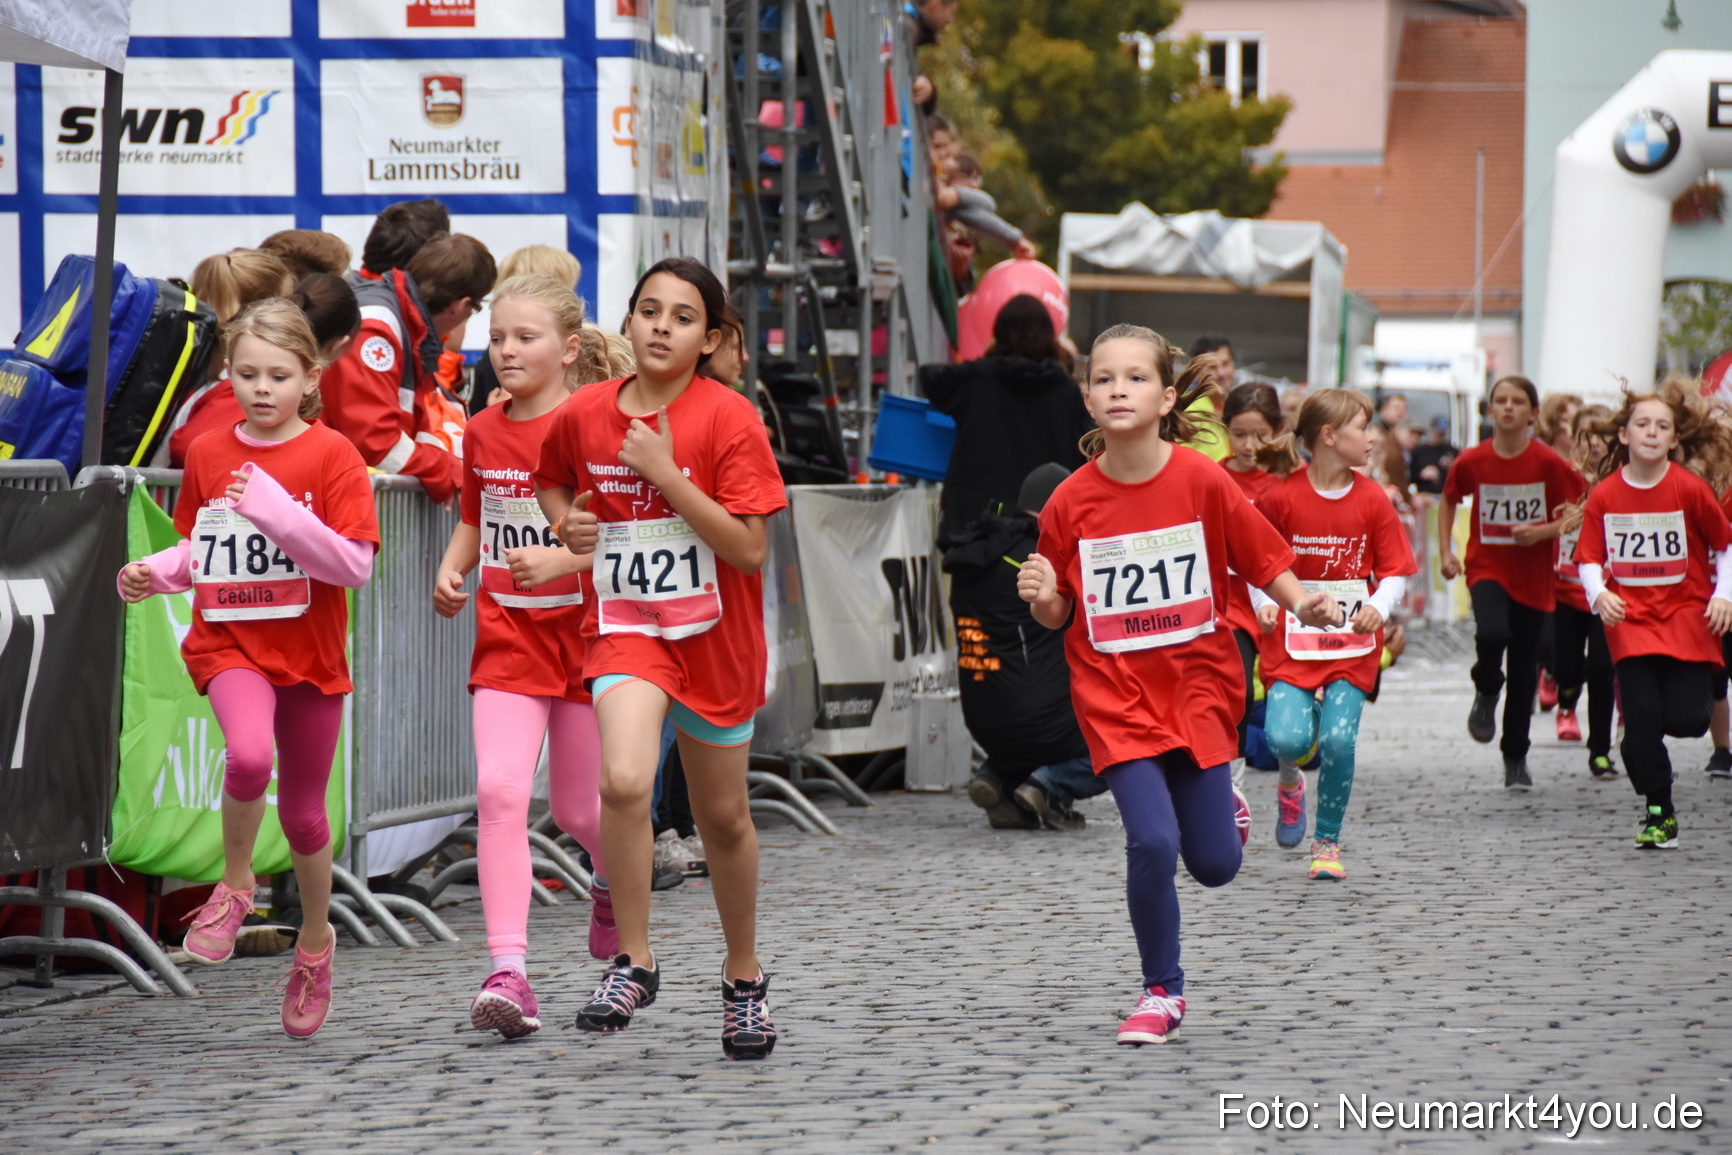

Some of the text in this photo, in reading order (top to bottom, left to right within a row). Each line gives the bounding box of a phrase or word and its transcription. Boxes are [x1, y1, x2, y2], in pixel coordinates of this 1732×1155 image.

[57, 106, 205, 144] swn
[55, 148, 244, 164] stadterke neumarkt
[389, 137, 501, 154] Neumarkter
[368, 157, 520, 181] Lammsbräu
[1486, 498, 1541, 521] 7182
[1133, 529, 1194, 551] BOCK
[1293, 534, 1347, 545] Neumarkter
[1614, 531, 1681, 558] 7218
[199, 533, 295, 576] 7184
[1292, 546, 1335, 557] Stadtlauf
[605, 545, 700, 594] 7421
[1093, 553, 1196, 608] 7217
[1632, 565, 1665, 576] Emma
[217, 588, 274, 604] Cecilia
[1125, 613, 1182, 634] Melina
